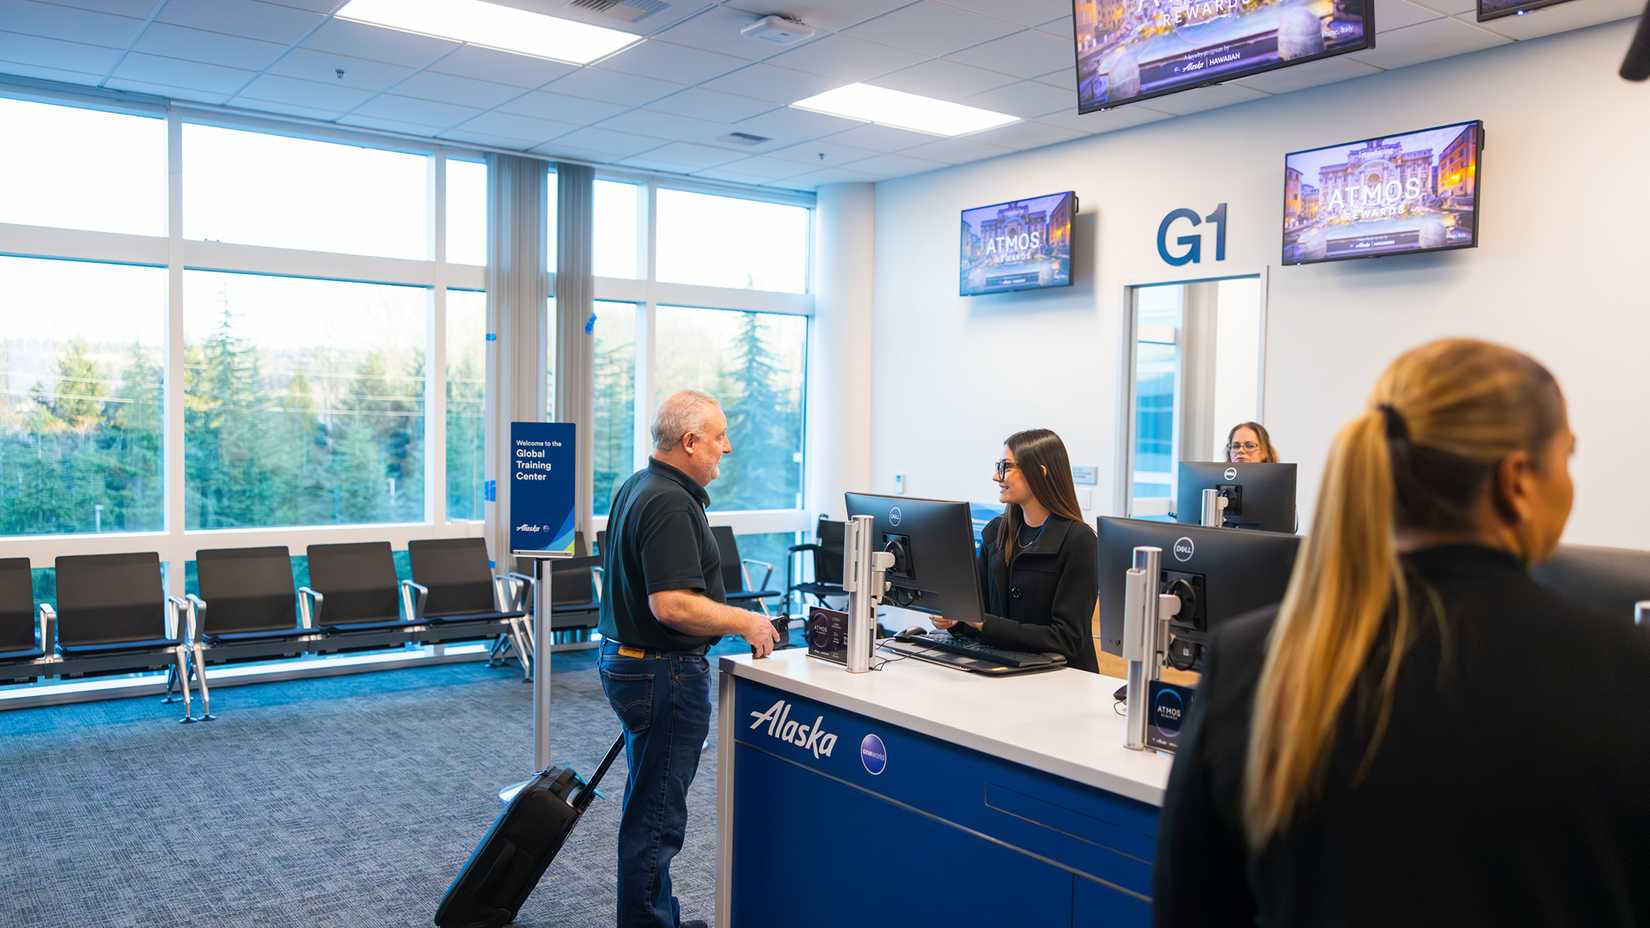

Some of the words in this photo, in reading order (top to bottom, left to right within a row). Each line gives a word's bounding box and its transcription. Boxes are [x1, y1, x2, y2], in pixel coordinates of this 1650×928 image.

[1328, 177, 1421, 210] ATMOS
[1157, 202, 1228, 267] G1
[985, 231, 1041, 256] ATMOS
[516, 449, 545, 458] Global
[516, 461, 552, 471] Training
[516, 472, 547, 481] Center
[1176, 545, 1192, 554] DELL
[1157, 705, 1182, 718] ATMOS
[750, 700, 839, 760] Alaska
